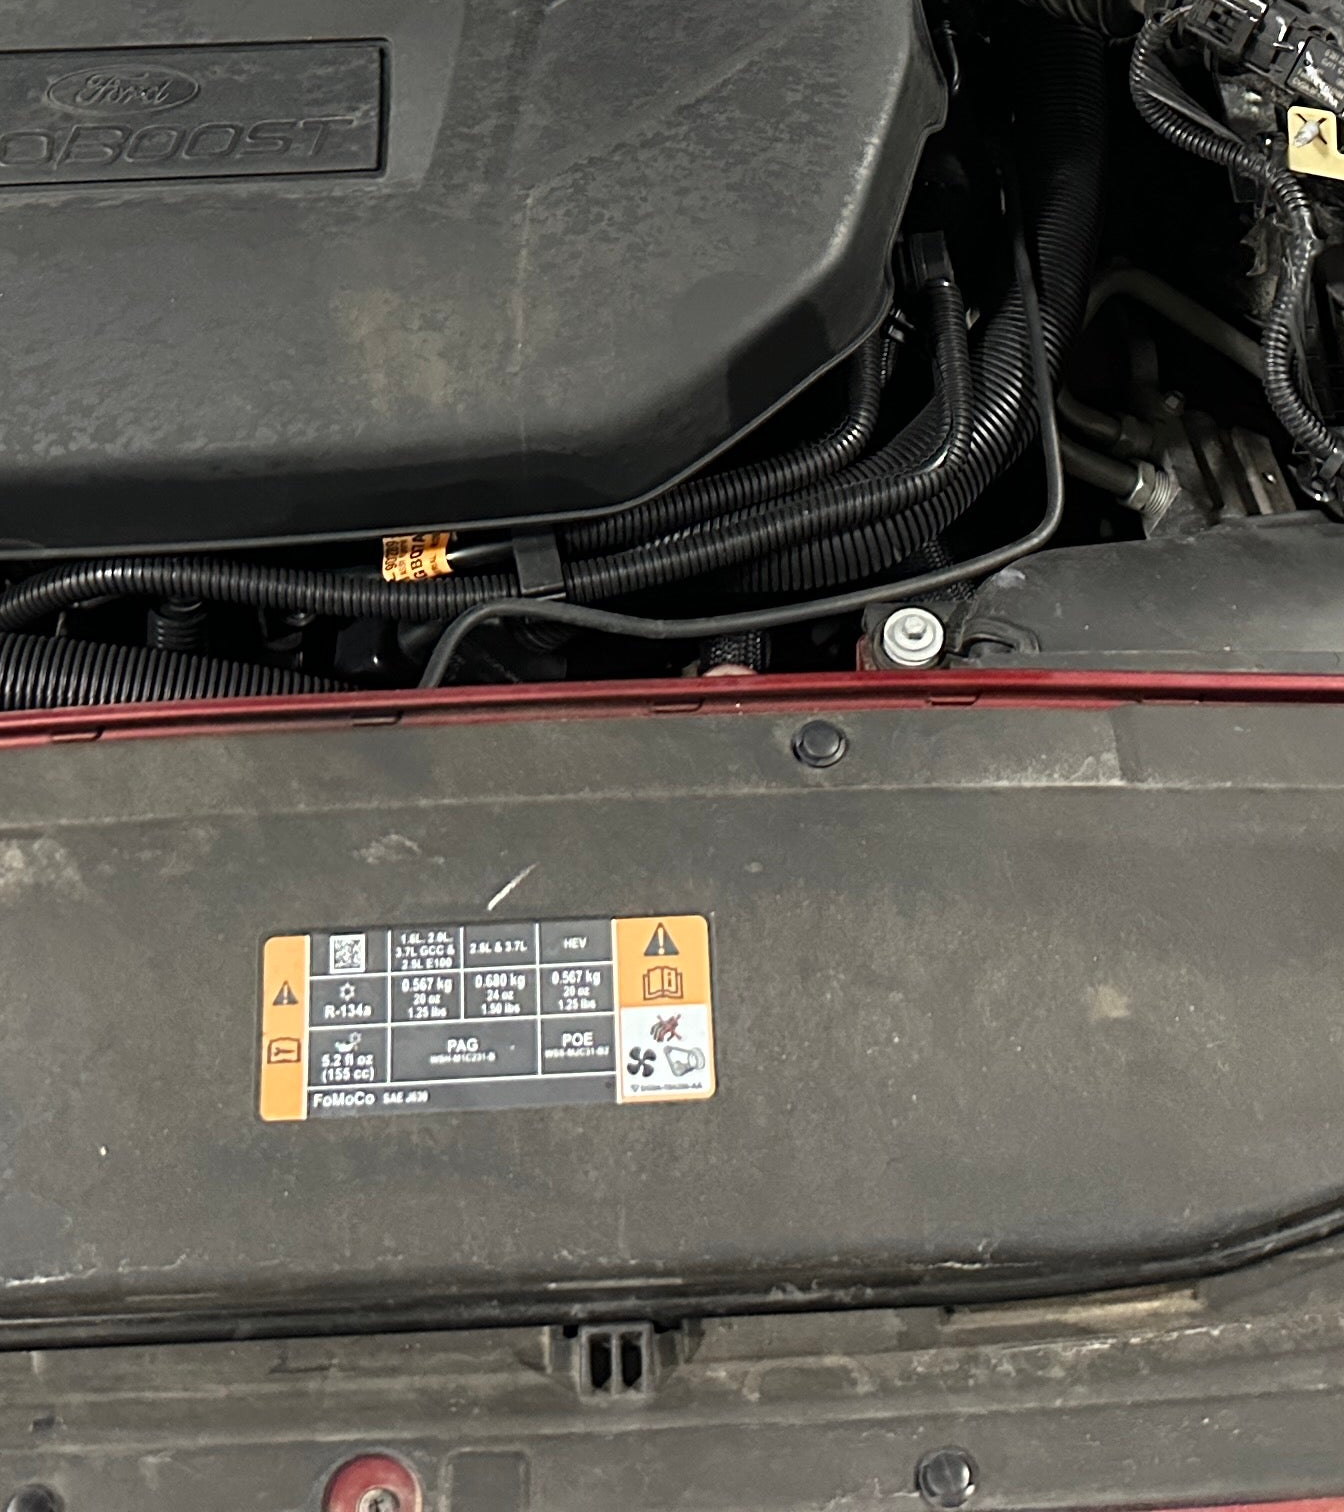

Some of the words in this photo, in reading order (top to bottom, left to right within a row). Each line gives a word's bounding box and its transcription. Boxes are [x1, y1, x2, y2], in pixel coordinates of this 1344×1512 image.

[75, 72, 174, 106] Ford
[494, 941, 503, 952] &
[563, 937, 588, 949] HEV
[419, 945, 444, 956] GCC
[474, 975, 507, 989] 0.680
[509, 973, 526, 990] kg
[551, 970, 583, 985] 0.567
[585, 968, 601, 986] kg
[401, 978, 434, 993] 0.567
[436, 976, 453, 994] kg
[563, 986, 576, 997] 20
[577, 986, 590, 996] oz
[412, 993, 426, 1005] 20
[427, 994, 441, 1004] oz
[486, 990, 500, 1002] 24
[501, 990, 514, 1000] oz
[504, 1002, 521, 1014] lbs
[580, 998, 597, 1009] lbs
[323, 1003, 373, 1019] R-134a
[430, 1006, 447, 1017] lbs
[447, 1037, 479, 1052] PAG
[562, 1032, 594, 1047] POE
[321, 1054, 342, 1067] 5.2
[344, 1054, 354, 1066] fl
[356, 1054, 374, 1066] oz
[321, 1068, 351, 1084] (155
[353, 1066, 375, 1081] cc)
[313, 1091, 376, 1108] FoMoCo
